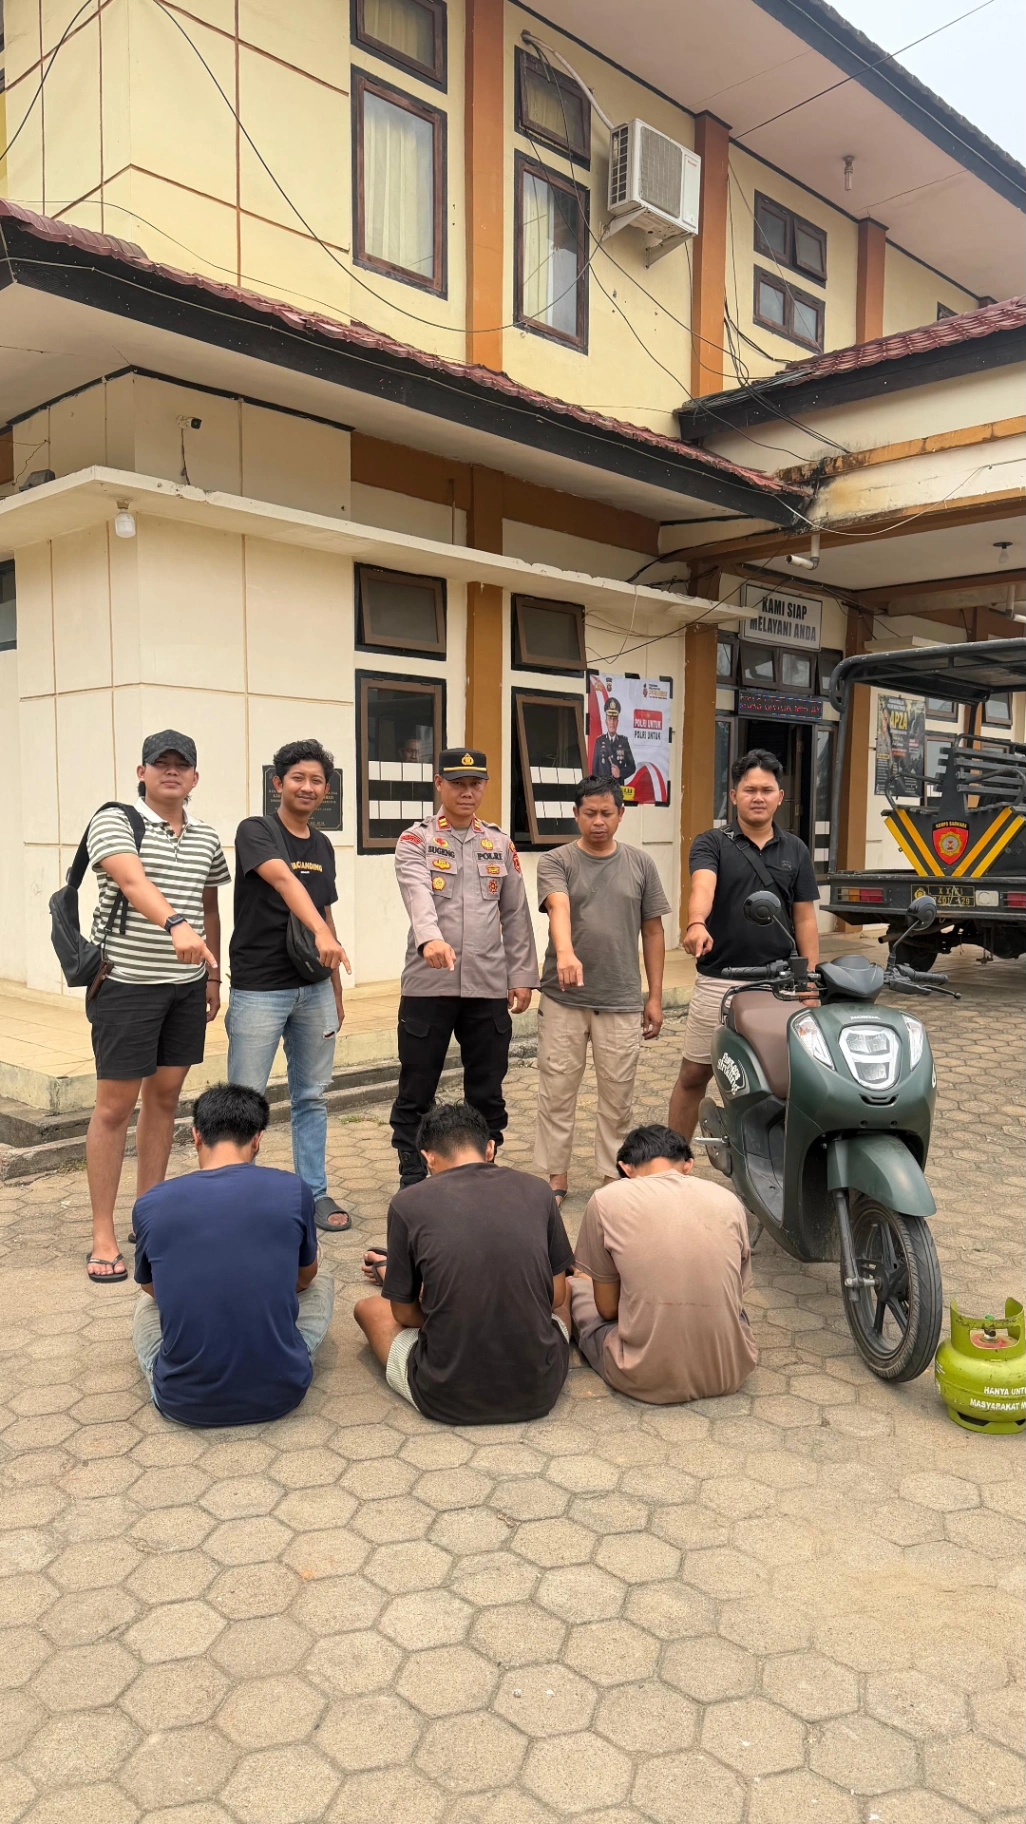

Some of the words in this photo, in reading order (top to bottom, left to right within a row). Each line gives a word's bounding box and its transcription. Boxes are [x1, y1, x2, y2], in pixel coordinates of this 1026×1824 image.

[762, 597, 785, 616] KAMI
[787, 602, 807, 620] SIAP
[750, 615, 792, 637] MELAYANI
[794, 623, 816, 642] ANDA
[634, 718, 647, 728] POLRI
[634, 730, 647, 739] POLRI
[428, 845, 455, 858] SUGENG
[477, 852, 502, 860] POLRI
[984, 1386, 1009, 1396] HANYA
[1011, 1386, 1026, 1396] UNT
[970, 1397, 1020, 1411] MASYARAKAT
